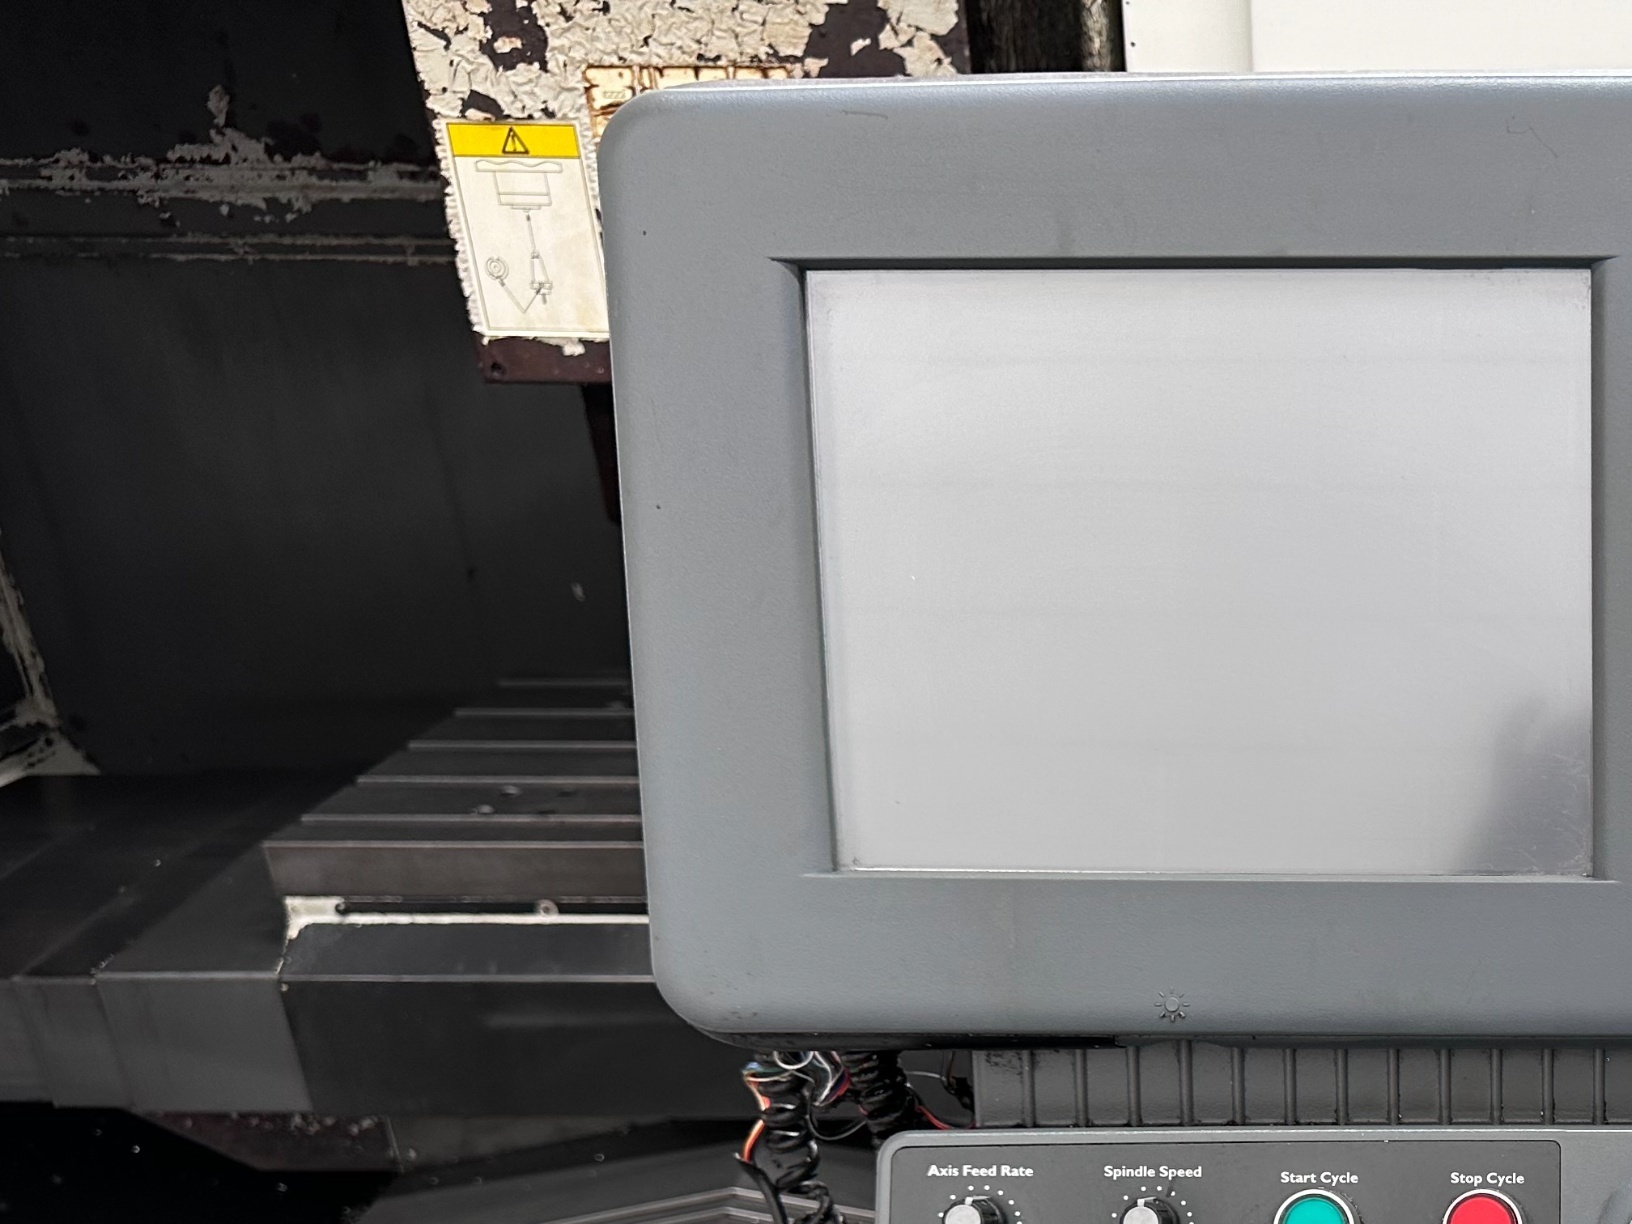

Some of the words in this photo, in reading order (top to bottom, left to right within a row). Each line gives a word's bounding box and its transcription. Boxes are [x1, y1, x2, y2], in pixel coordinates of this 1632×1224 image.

[926, 1164, 959, 1176] Axis
[962, 1164, 996, 1176] Feed
[1000, 1164, 1033, 1176] Rate
[1103, 1165, 1155, 1180] Spindle
[1158, 1165, 1201, 1180] Speed
[1280, 1171, 1316, 1183] Start
[1319, 1171, 1358, 1186] Cycle
[1450, 1171, 1482, 1186] Stop
[1486, 1172, 1524, 1186] Cycle
